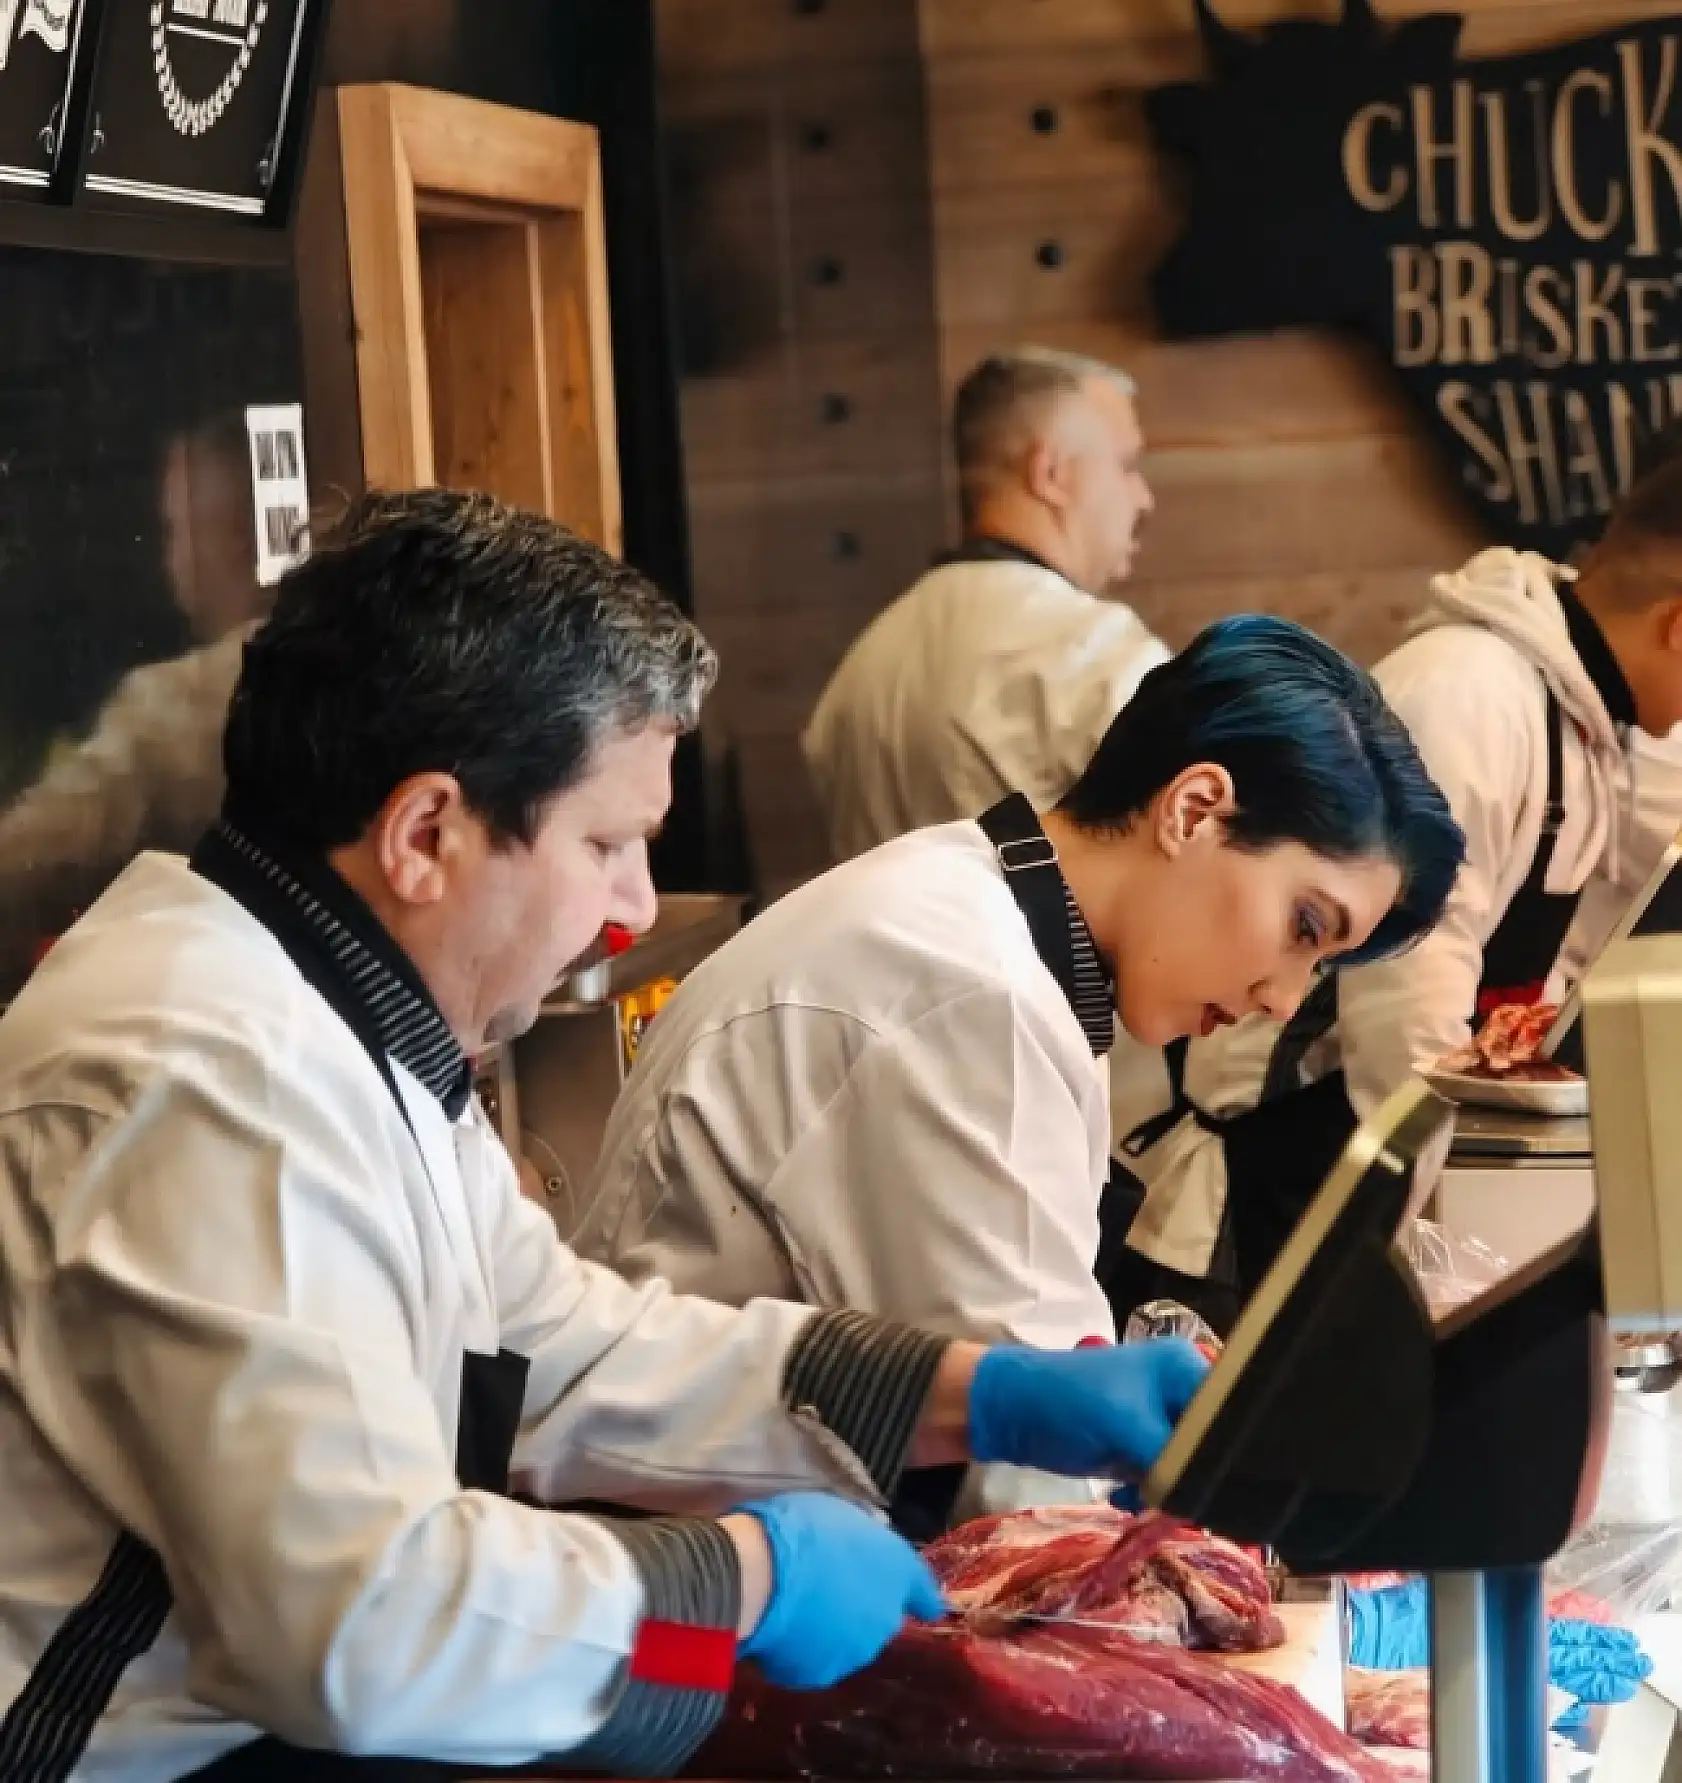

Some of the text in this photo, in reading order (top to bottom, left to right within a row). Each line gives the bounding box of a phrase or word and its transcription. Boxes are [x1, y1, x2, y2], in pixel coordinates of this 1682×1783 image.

[1341, 35, 1682, 256] CHUCK
[1388, 241, 1682, 369] BRISKE
[1435, 374, 1682, 525] SHAN
